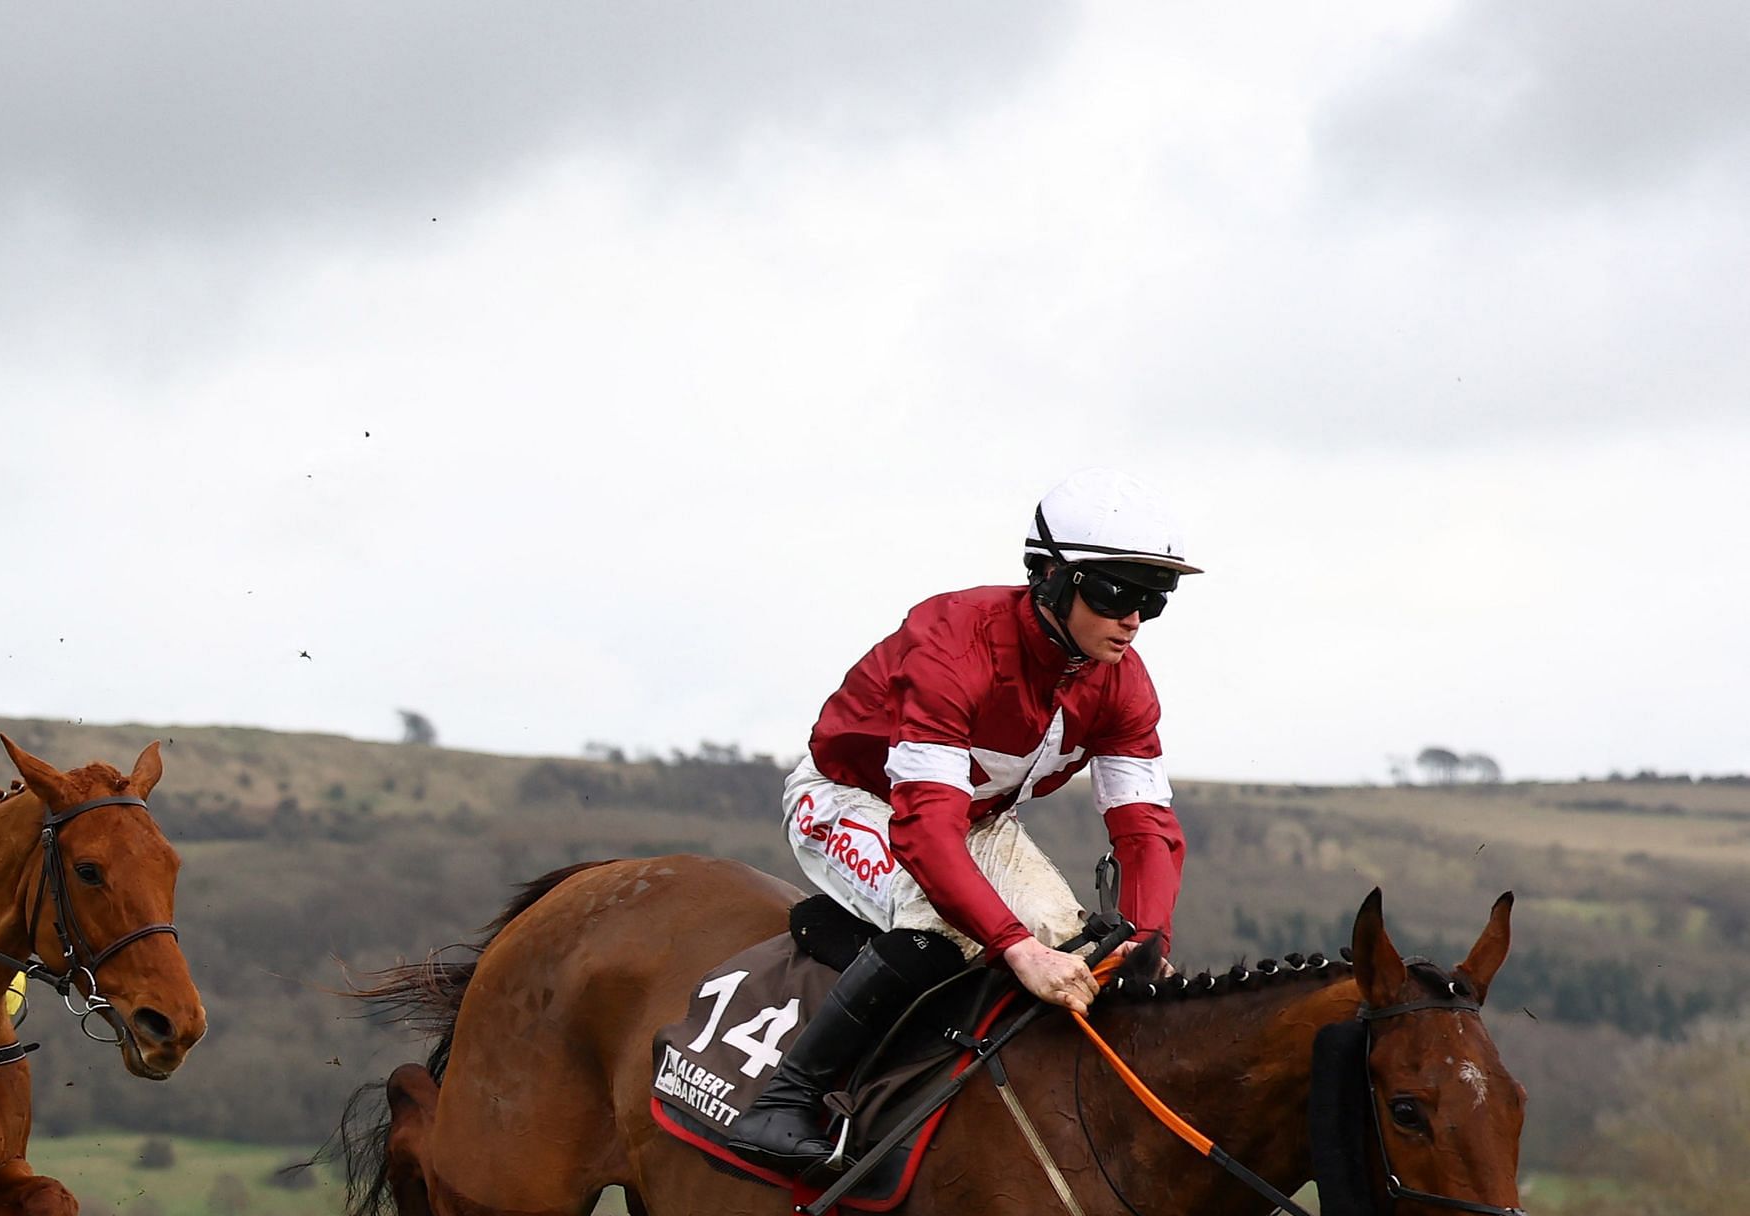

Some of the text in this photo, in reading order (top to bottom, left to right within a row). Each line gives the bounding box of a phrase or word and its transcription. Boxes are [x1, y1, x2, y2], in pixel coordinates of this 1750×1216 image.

[686, 970, 800, 1079] 14
[674, 1077, 741, 1127] BARTLETT
[677, 1058, 736, 1100] ALBERT
